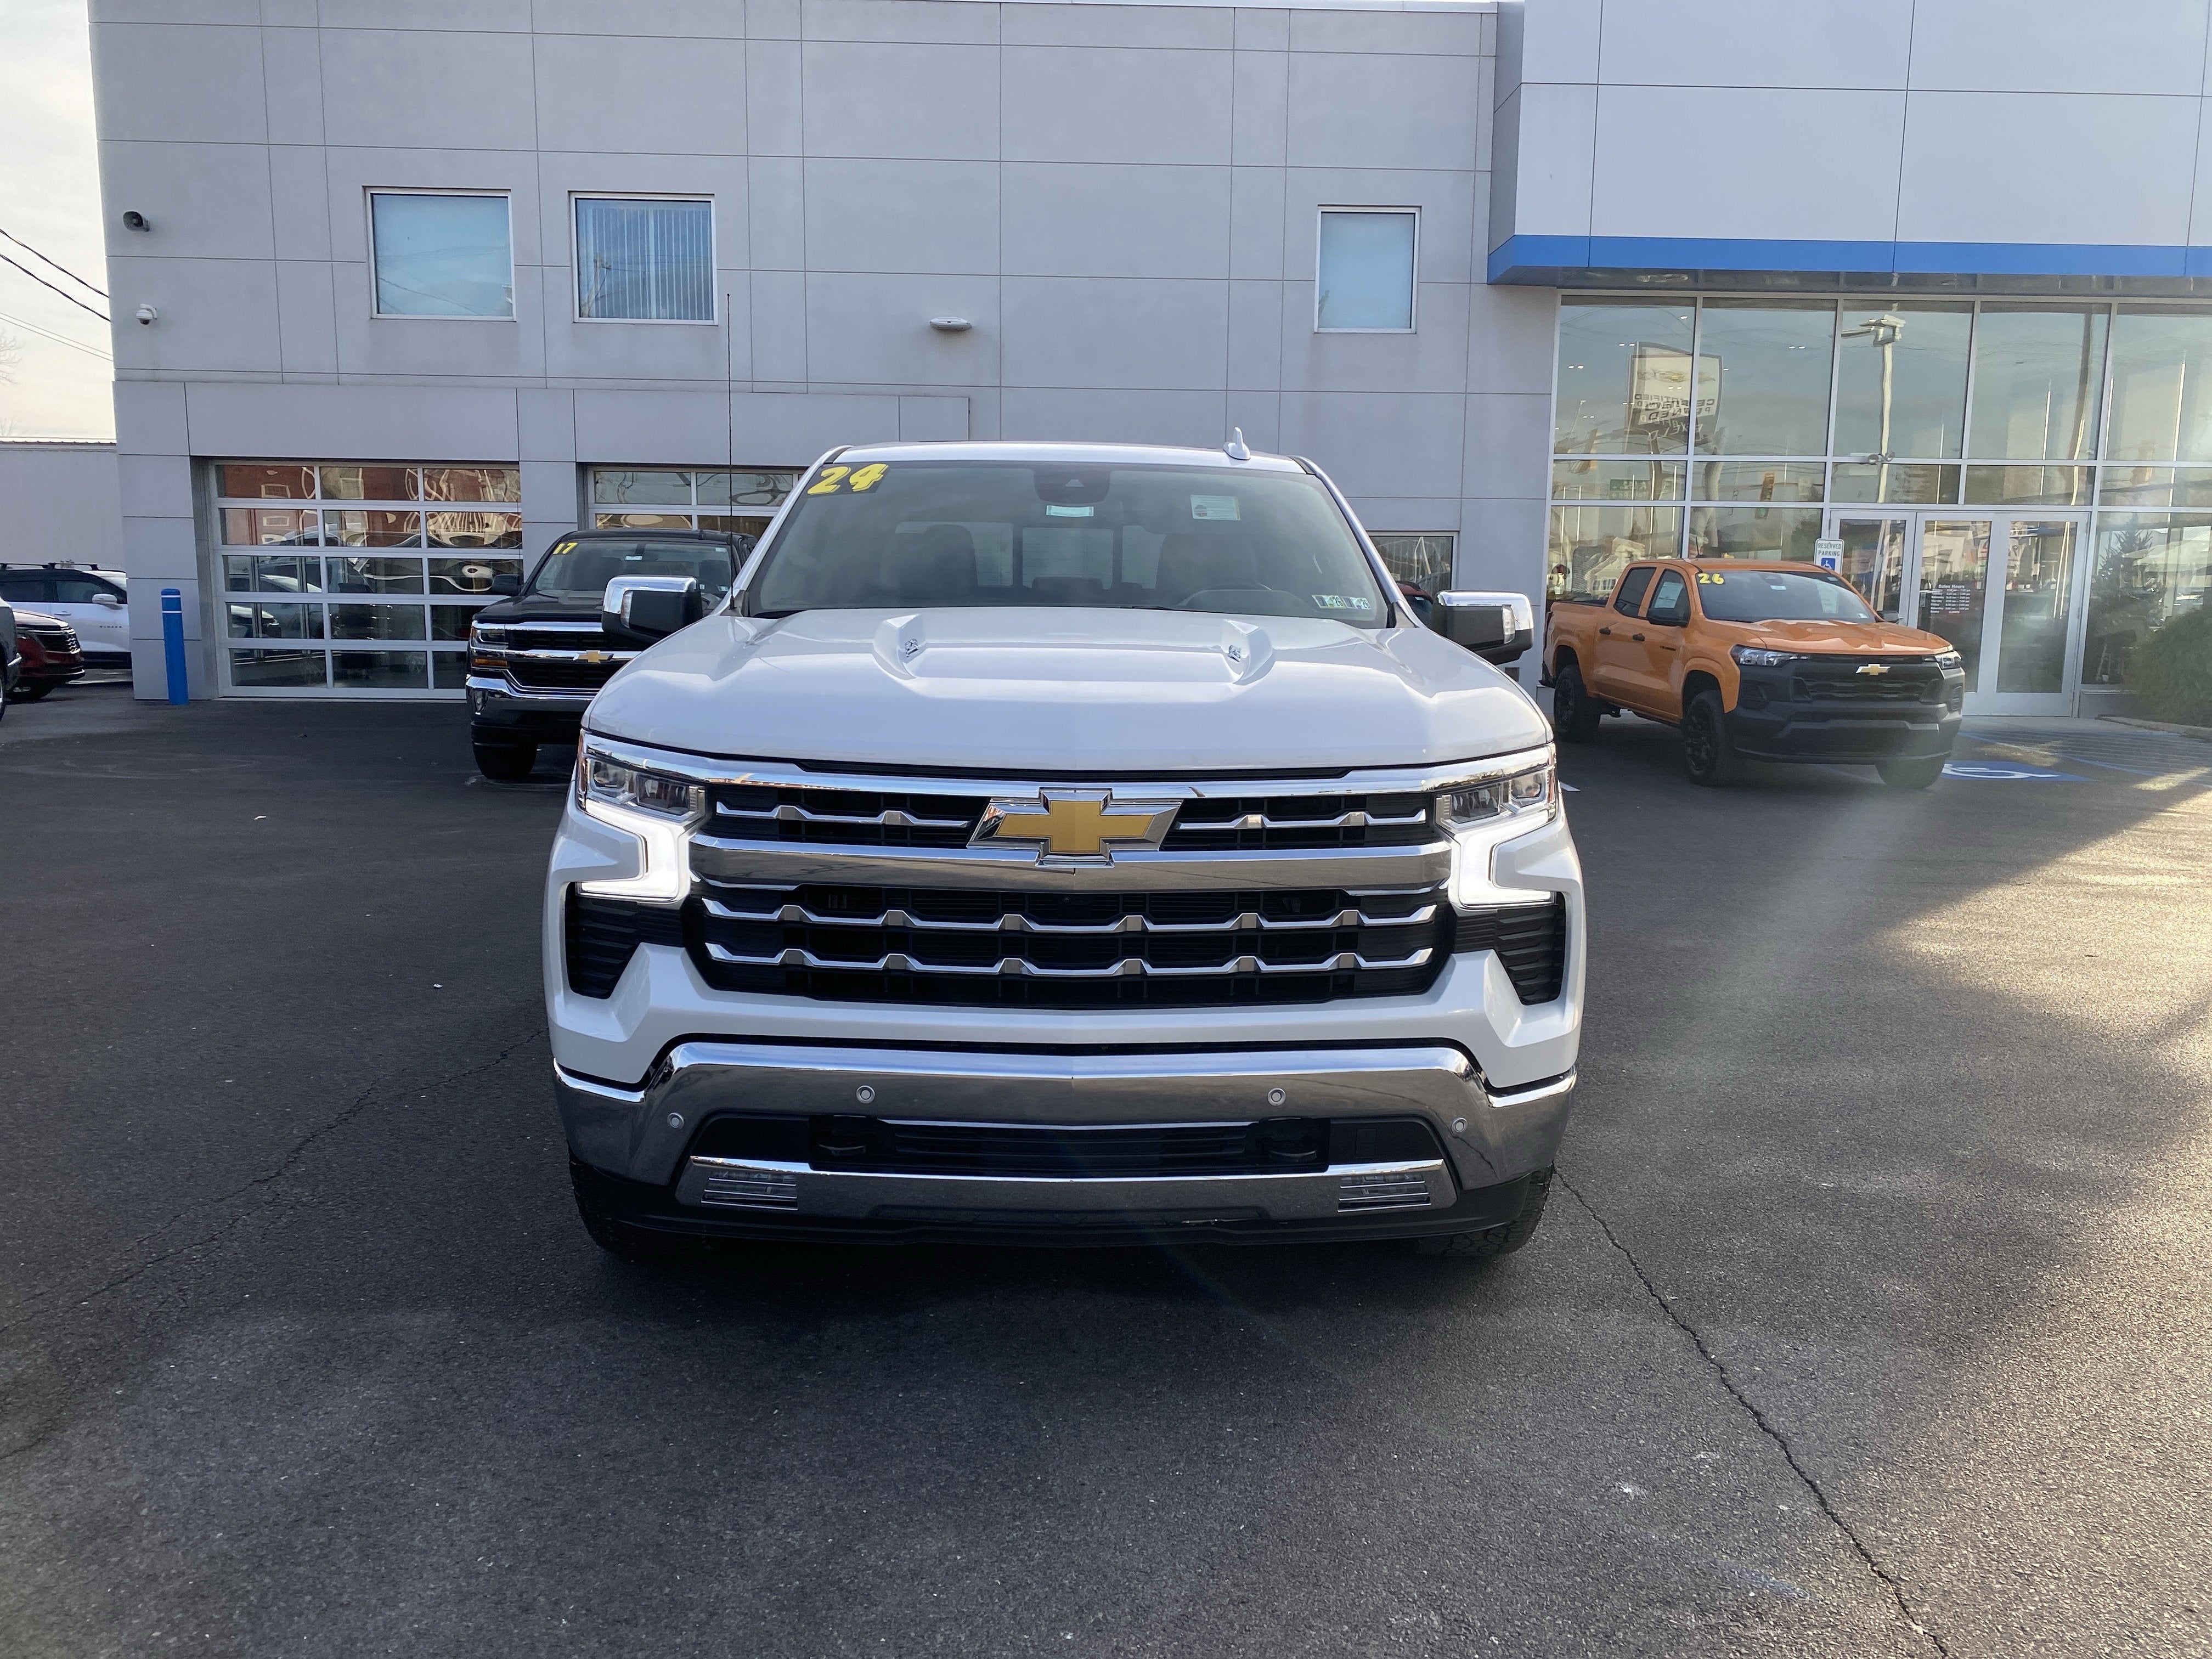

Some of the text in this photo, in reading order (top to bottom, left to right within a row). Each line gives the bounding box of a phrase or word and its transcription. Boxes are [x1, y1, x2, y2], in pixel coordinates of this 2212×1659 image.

[808, 464, 889, 495] 24
[553, 543, 578, 555] 17
[1698, 573, 1724, 584] 26
